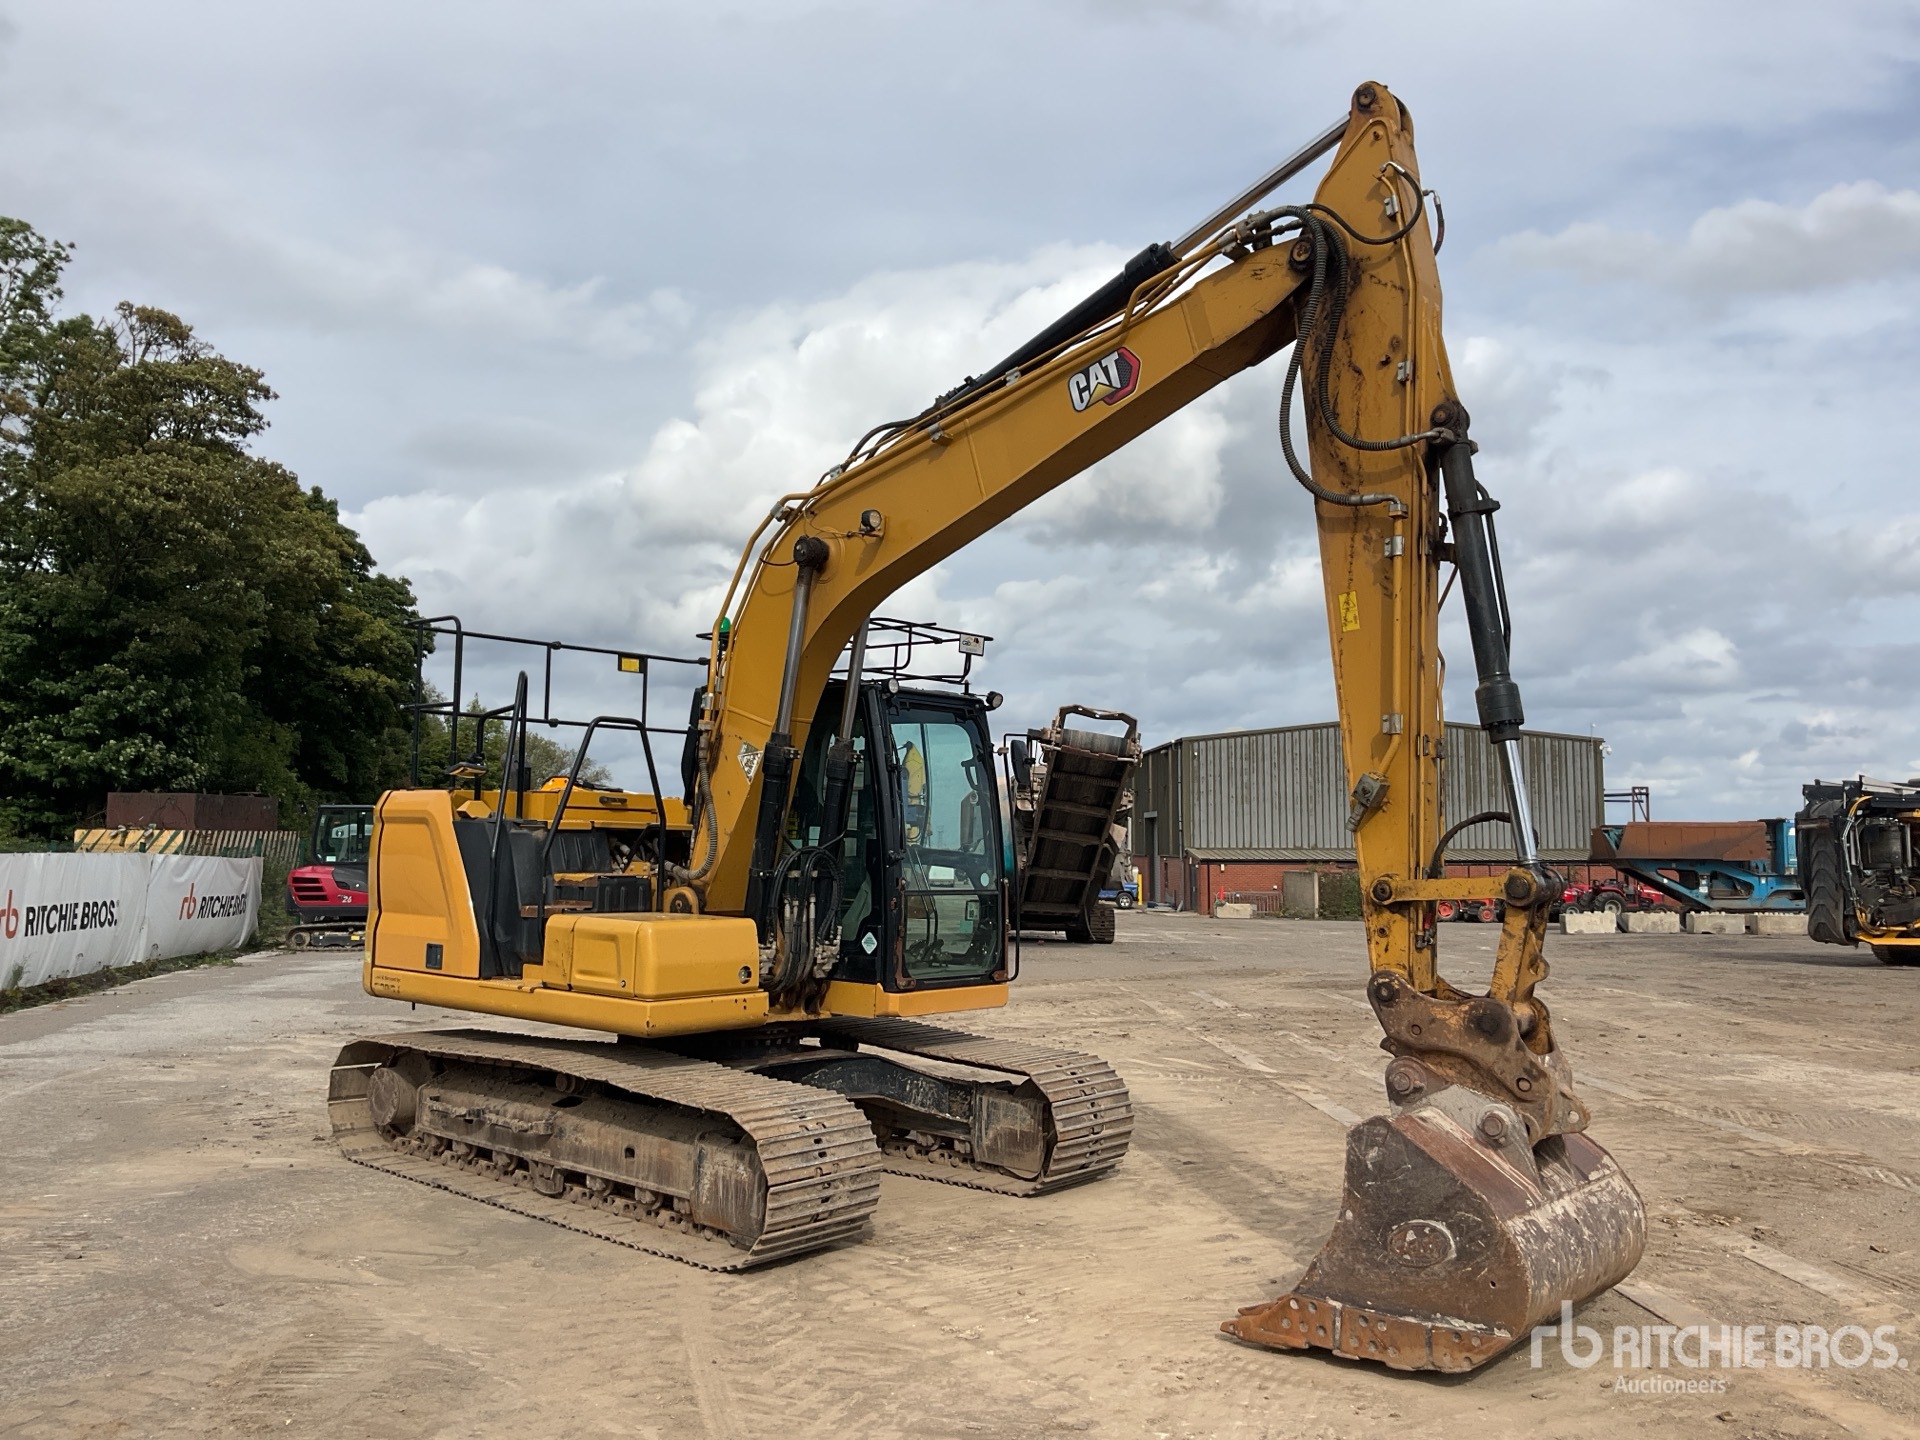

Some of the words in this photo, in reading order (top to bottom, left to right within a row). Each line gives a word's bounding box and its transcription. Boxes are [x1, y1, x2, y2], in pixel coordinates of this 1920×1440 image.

[1069, 351, 1121, 412] CAT
[24, 902, 79, 937] RITCHIE
[79, 900, 118, 931] BROS.
[197, 895, 235, 919] RITCHIE
